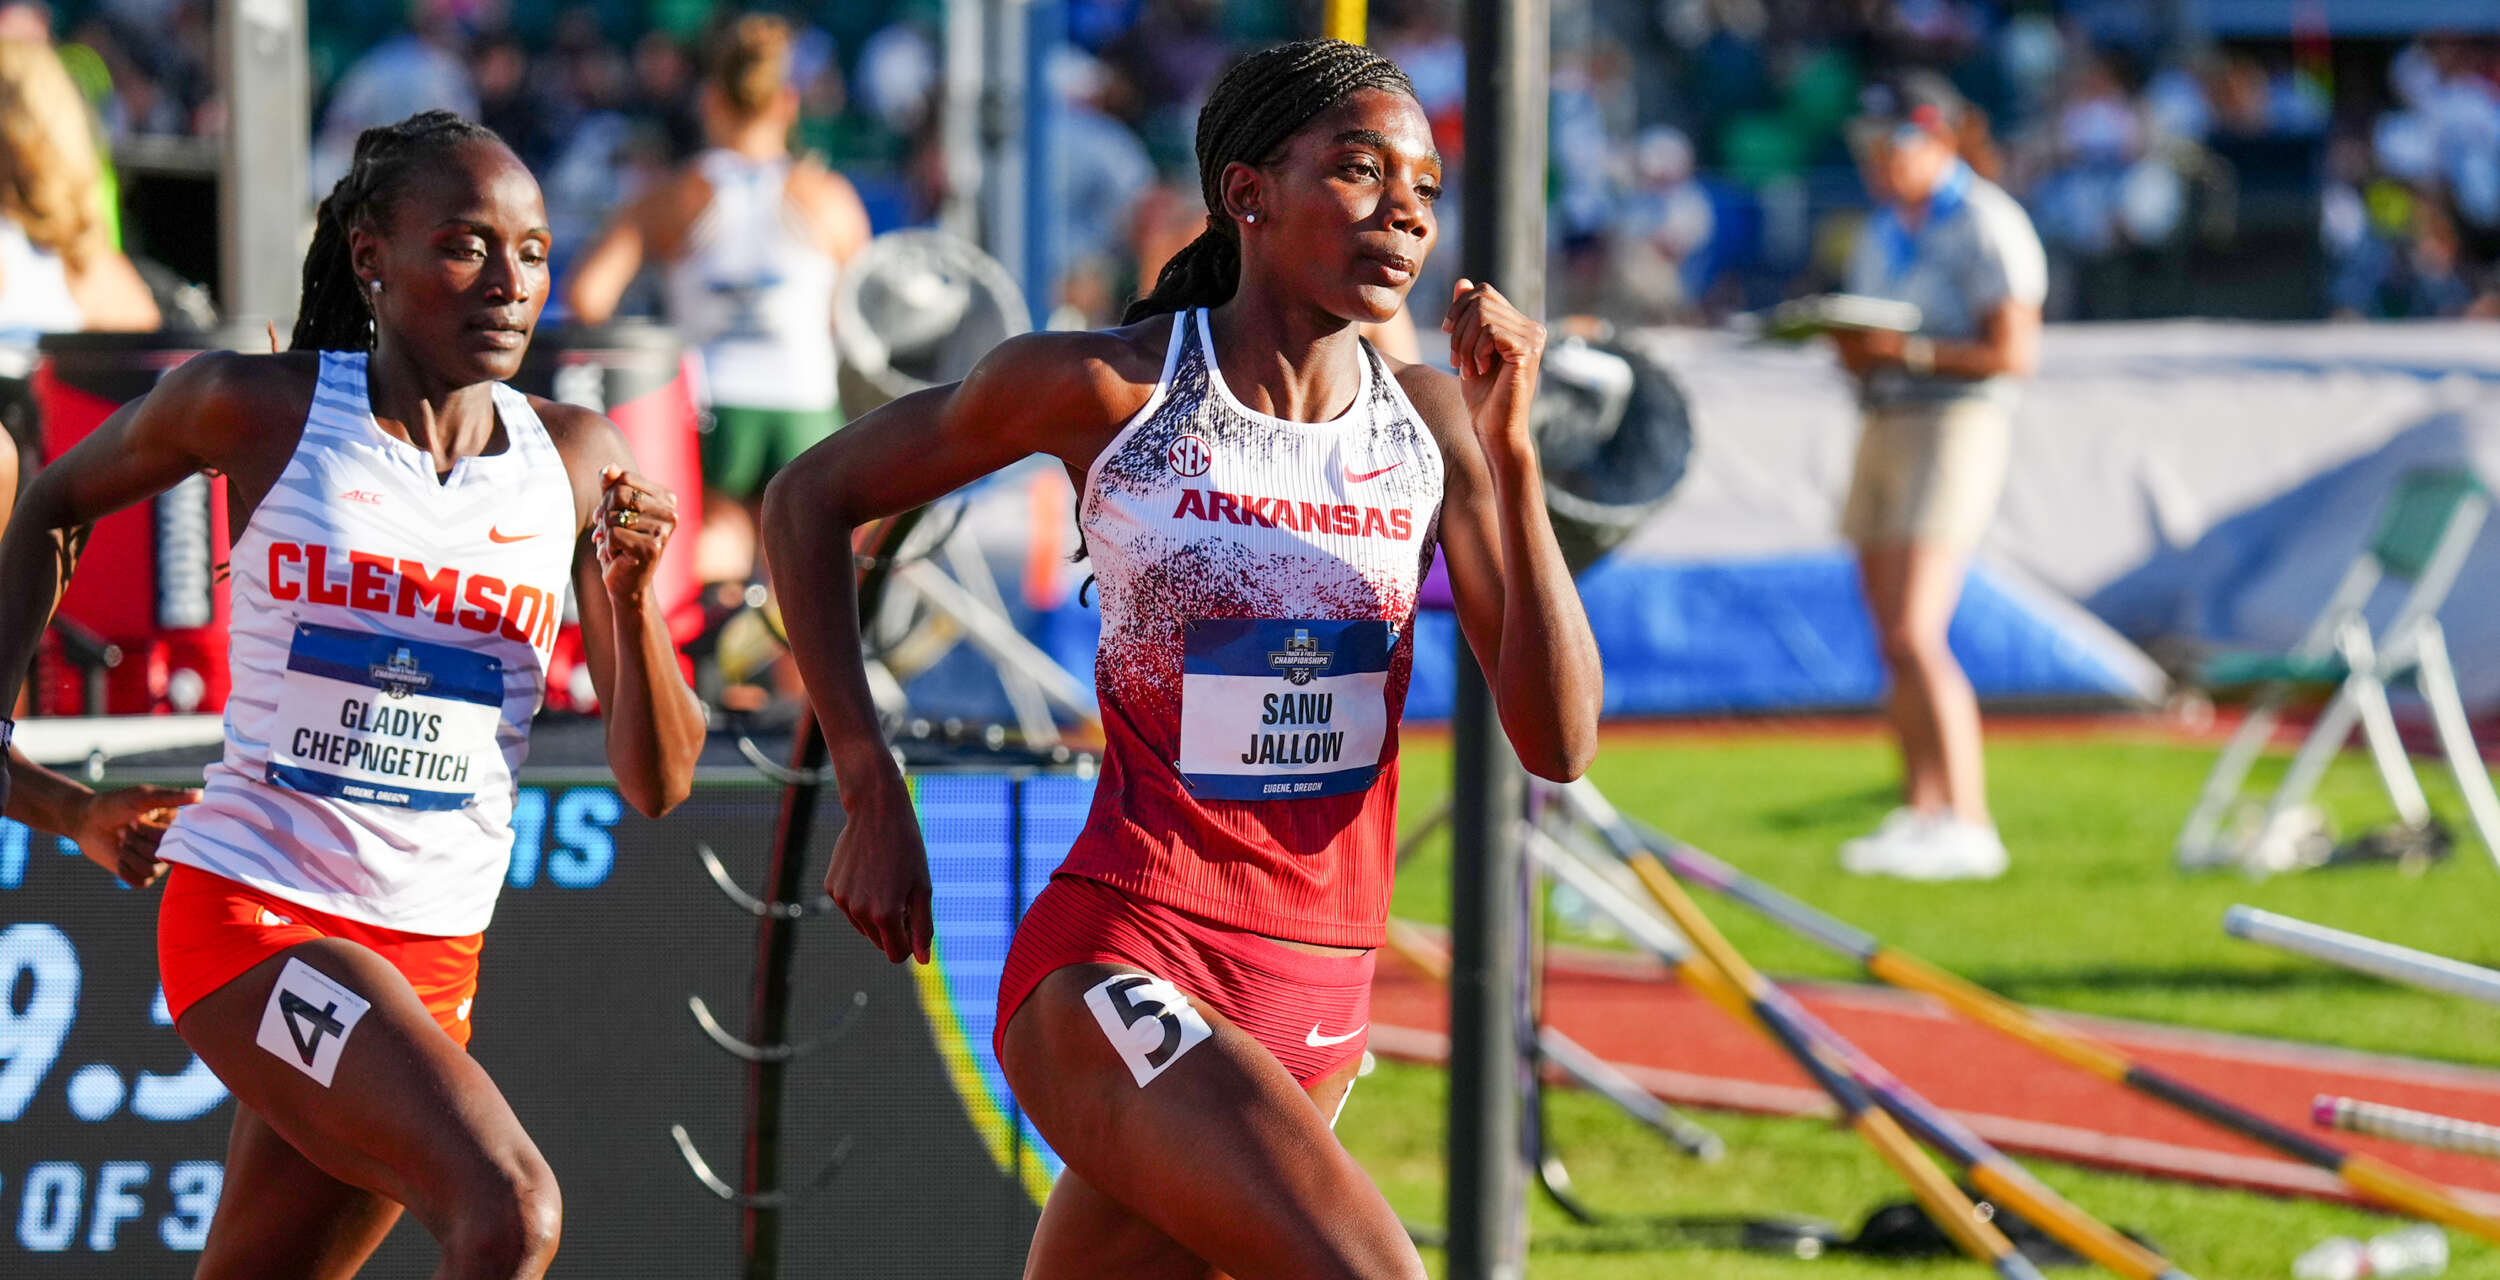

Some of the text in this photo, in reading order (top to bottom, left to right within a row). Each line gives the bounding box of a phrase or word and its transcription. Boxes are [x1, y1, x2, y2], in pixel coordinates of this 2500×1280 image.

[1171, 436, 1210, 475] SEC
[339, 489, 384, 505] ACC
[1173, 489, 1412, 541] ARKANSAS
[268, 541, 555, 653] CLEMSON
[1274, 656, 1328, 665] CHAMPIONSHIPS
[340, 698, 442, 743] GLADYS
[1262, 693, 1333, 725] SANU
[292, 728, 469, 783] CHEPNGETICH
[1241, 731, 1344, 765] JALLOW
[1264, 781, 1323, 793] EUGENE, OREGON
[278, 988, 346, 1068] 4
[1106, 977, 1182, 1069] 5
